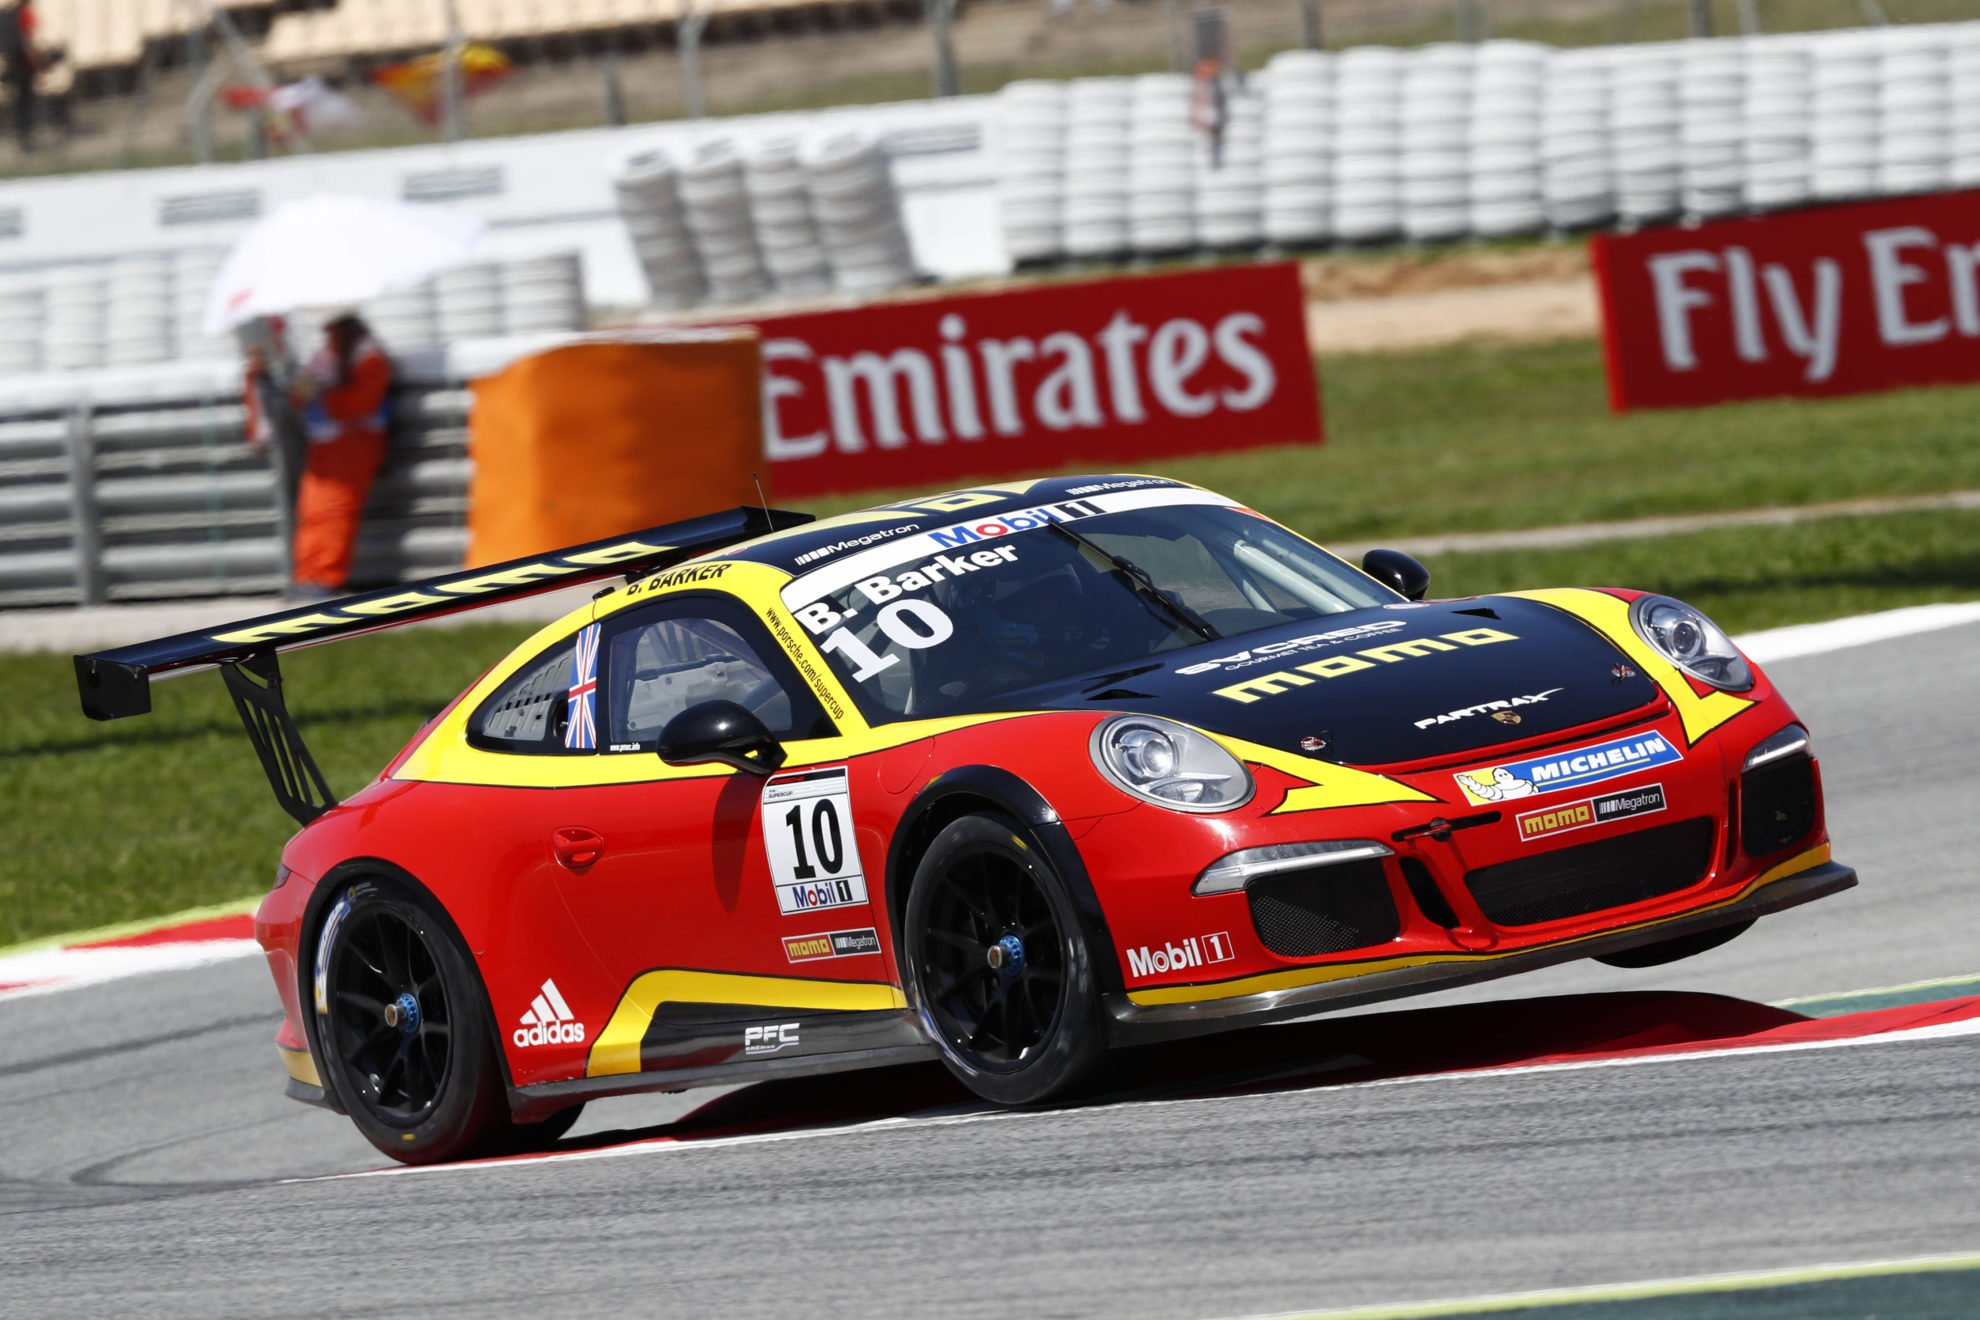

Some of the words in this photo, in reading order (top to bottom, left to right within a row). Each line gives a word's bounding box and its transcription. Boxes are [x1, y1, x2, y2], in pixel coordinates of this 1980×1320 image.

[1647, 246, 1842, 381] Fly
[762, 310, 1276, 460] Emirates
[827, 523, 920, 553] Megatron
[928, 508, 1064, 548] Mobil
[648, 564, 732, 591] BARKER
[794, 602, 858, 635] B.
[855, 544, 1018, 605] Barker
[820, 598, 953, 683] 10
[1344, 627, 1404, 642] COFFEE
[766, 608, 844, 720] www.porsche.com/supercup
[1413, 687, 1564, 729] PARTRAX
[1531, 737, 1667, 781] MICHELIN
[1615, 792, 1660, 812] Megatron
[786, 798, 843, 880] 10
[792, 882, 837, 908] Mobil
[838, 880, 852, 901] 1
[847, 935, 876, 950] Megatron
[1126, 937, 1202, 978] Mobil
[1209, 935, 1224, 960] 1
[513, 1019, 585, 1048] adidas
[745, 1023, 800, 1046] PFC
